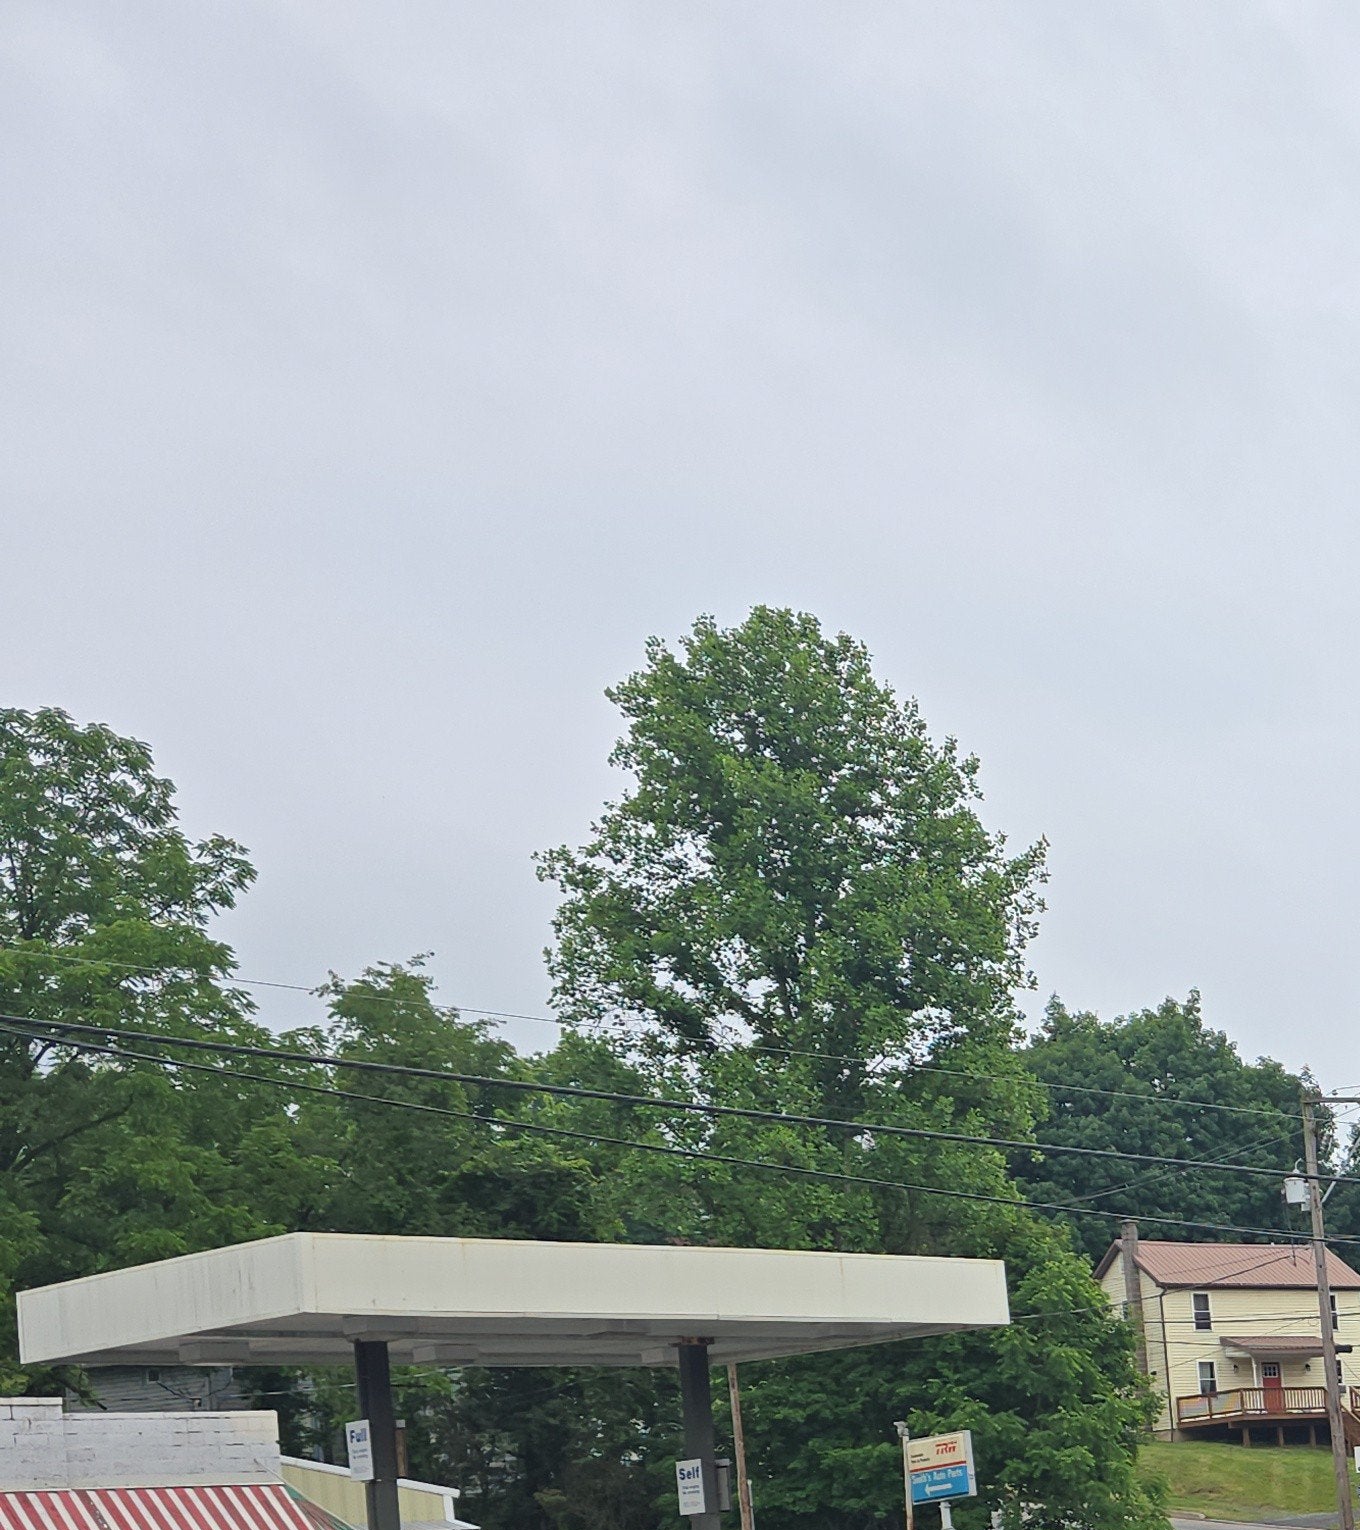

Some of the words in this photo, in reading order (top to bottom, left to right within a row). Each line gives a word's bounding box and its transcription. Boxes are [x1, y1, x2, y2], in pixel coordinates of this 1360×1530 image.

[935, 1440, 957, 1455] TRW
[678, 1465, 700, 1481] Self
[948, 1468, 963, 1478] Parts
